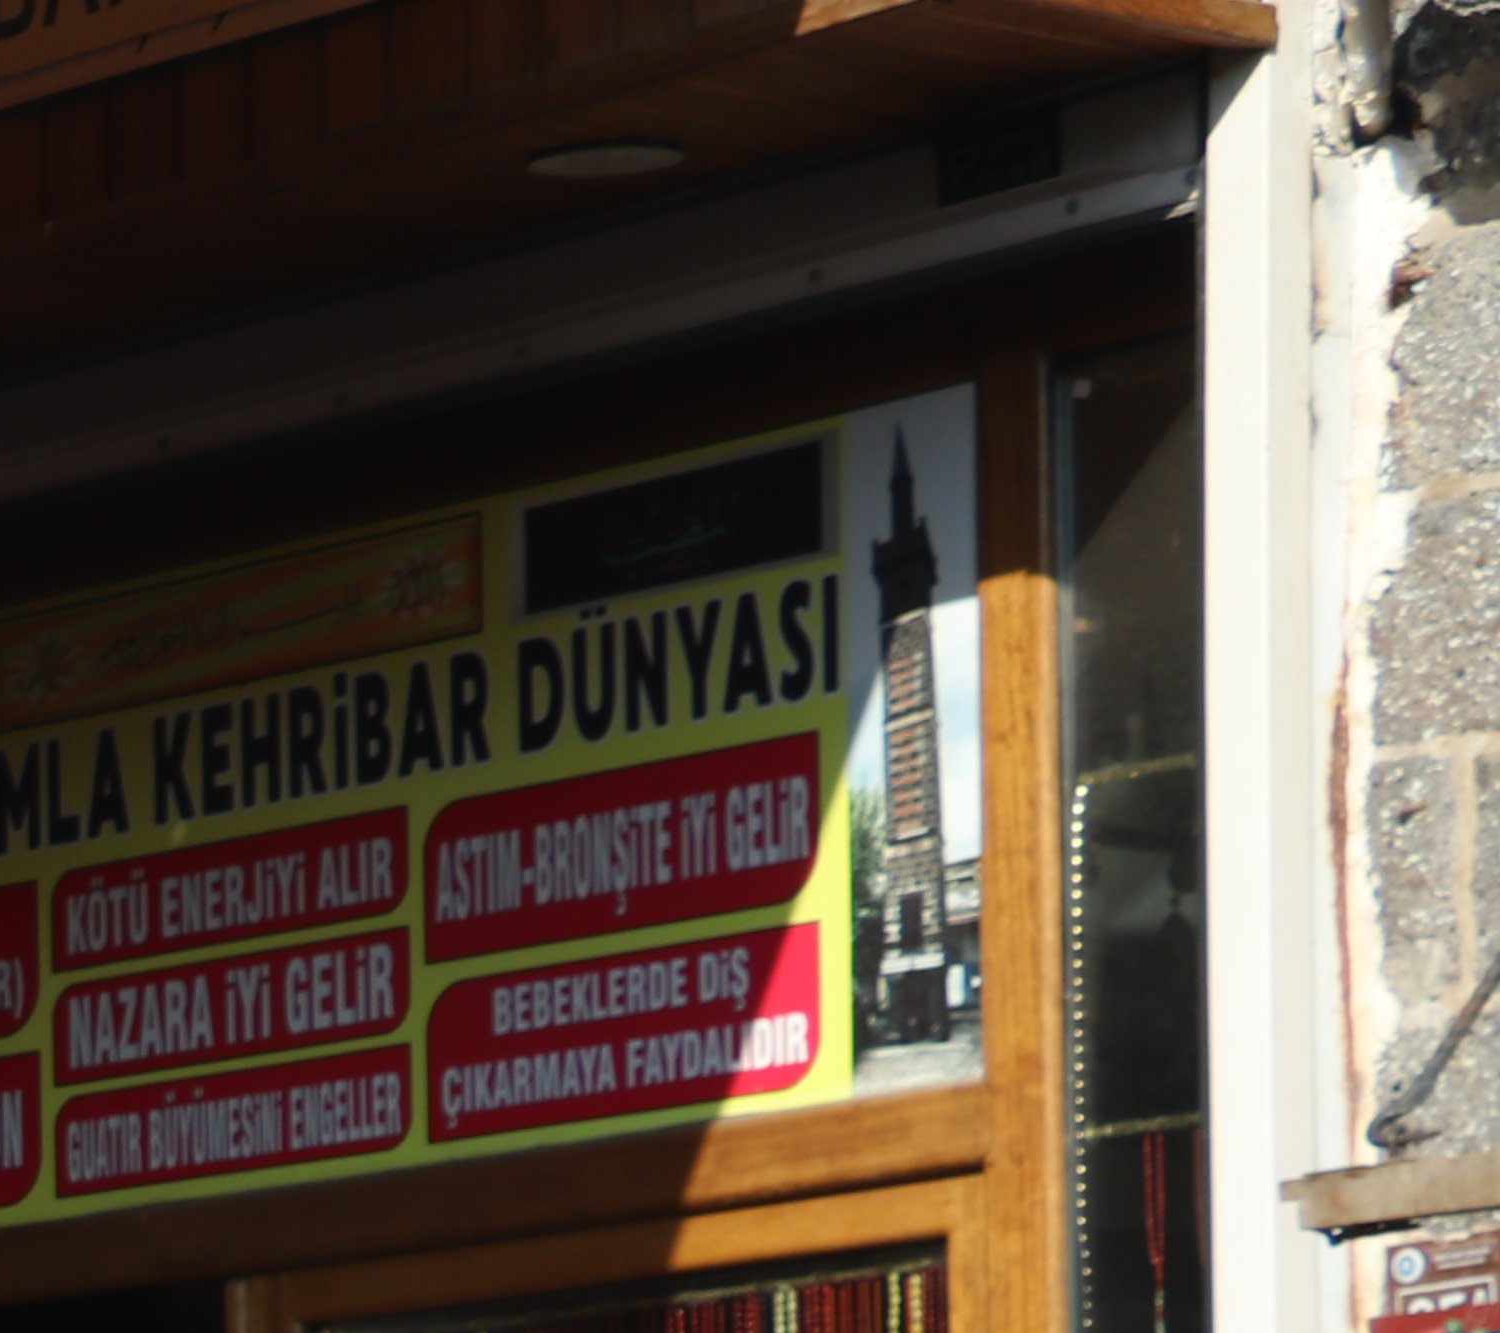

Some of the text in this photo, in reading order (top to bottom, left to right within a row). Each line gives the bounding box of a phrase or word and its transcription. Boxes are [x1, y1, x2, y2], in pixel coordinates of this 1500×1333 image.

[518, 574, 838, 753] DÜNYASI
[66, 868, 150, 957] KÖTÜ
[316, 836, 394, 912] ALIR
[67, 974, 216, 1071] NAZARA
[491, 957, 689, 1037] BEBEKLERDE
[66, 1112, 144, 1185] GUATIR
[288, 1071, 403, 1152] ENGELLER
[441, 1011, 810, 1130] ÇIKARMAYA FAYDALIDIR
